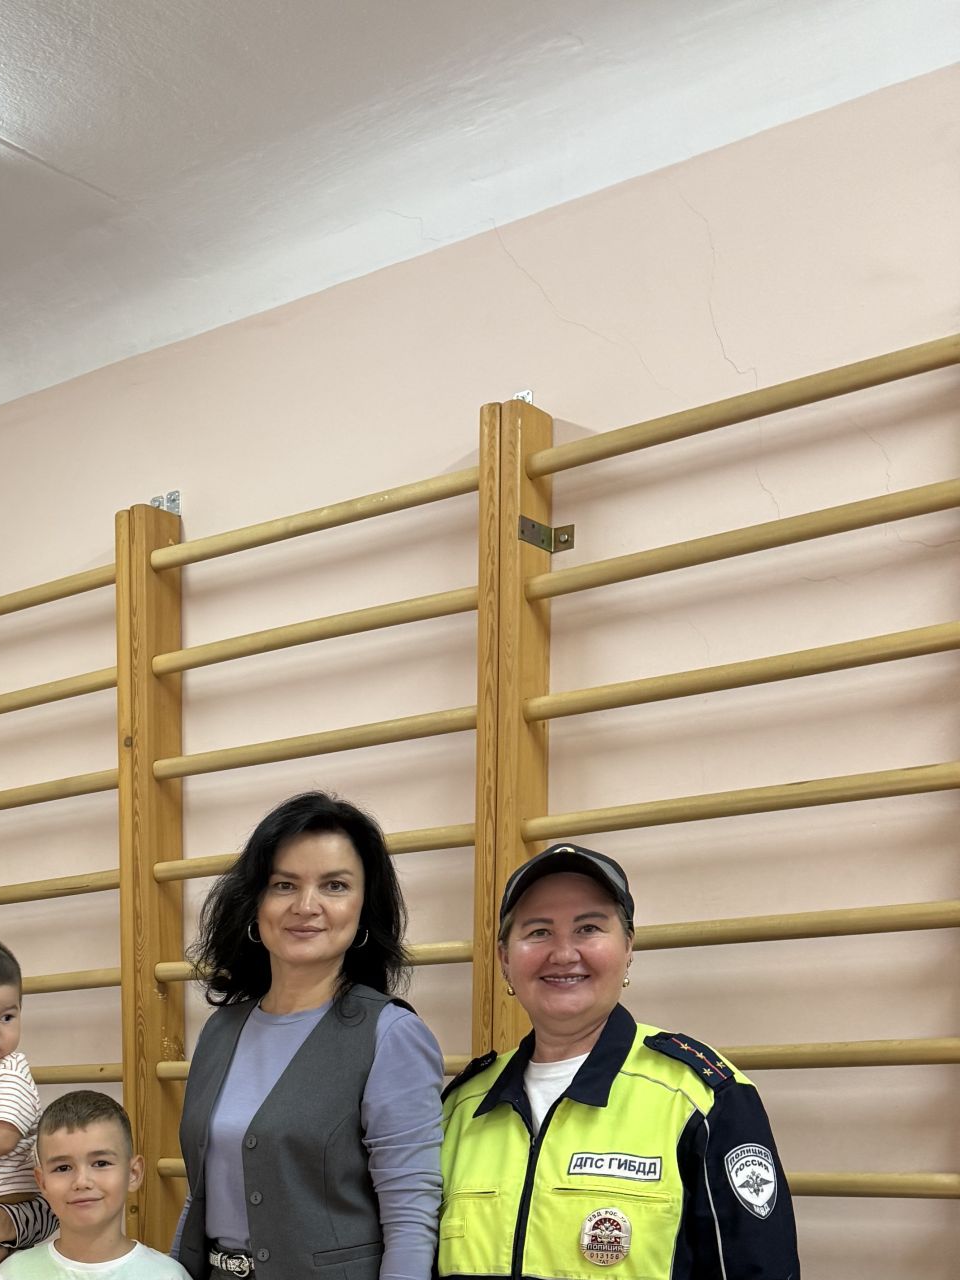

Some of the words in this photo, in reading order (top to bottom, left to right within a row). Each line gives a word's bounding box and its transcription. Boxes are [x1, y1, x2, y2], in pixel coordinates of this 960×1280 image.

[729, 1147, 770, 1166] ПОЛИЦИЯ
[573, 1157, 604, 1170] ДПС
[608, 1158, 657, 1176] ГИБДД
[735, 1159, 770, 1177] РОССИЯ
[587, 1243, 623, 1252] ПОЛИЦИЯ
